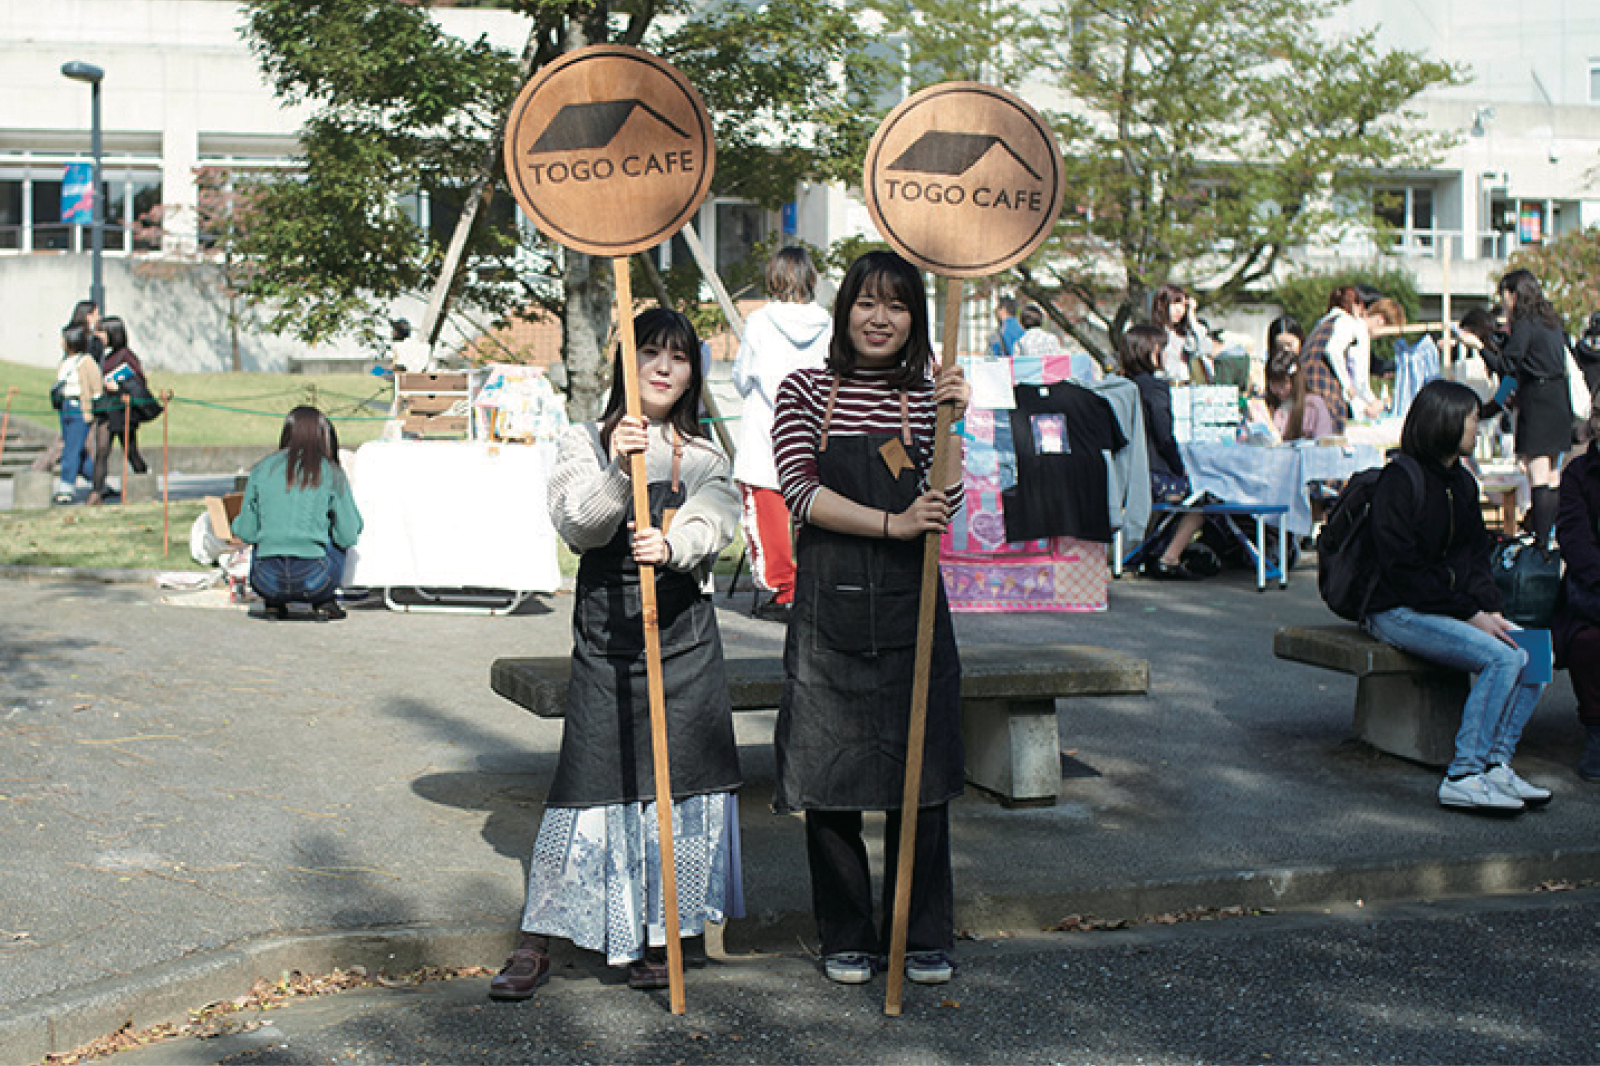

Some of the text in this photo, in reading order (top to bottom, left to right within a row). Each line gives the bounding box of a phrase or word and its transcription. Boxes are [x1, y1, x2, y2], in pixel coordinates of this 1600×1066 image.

[528, 150, 694, 185] TOGO CAFE
[885, 178, 1043, 211] TOGO CAFE
